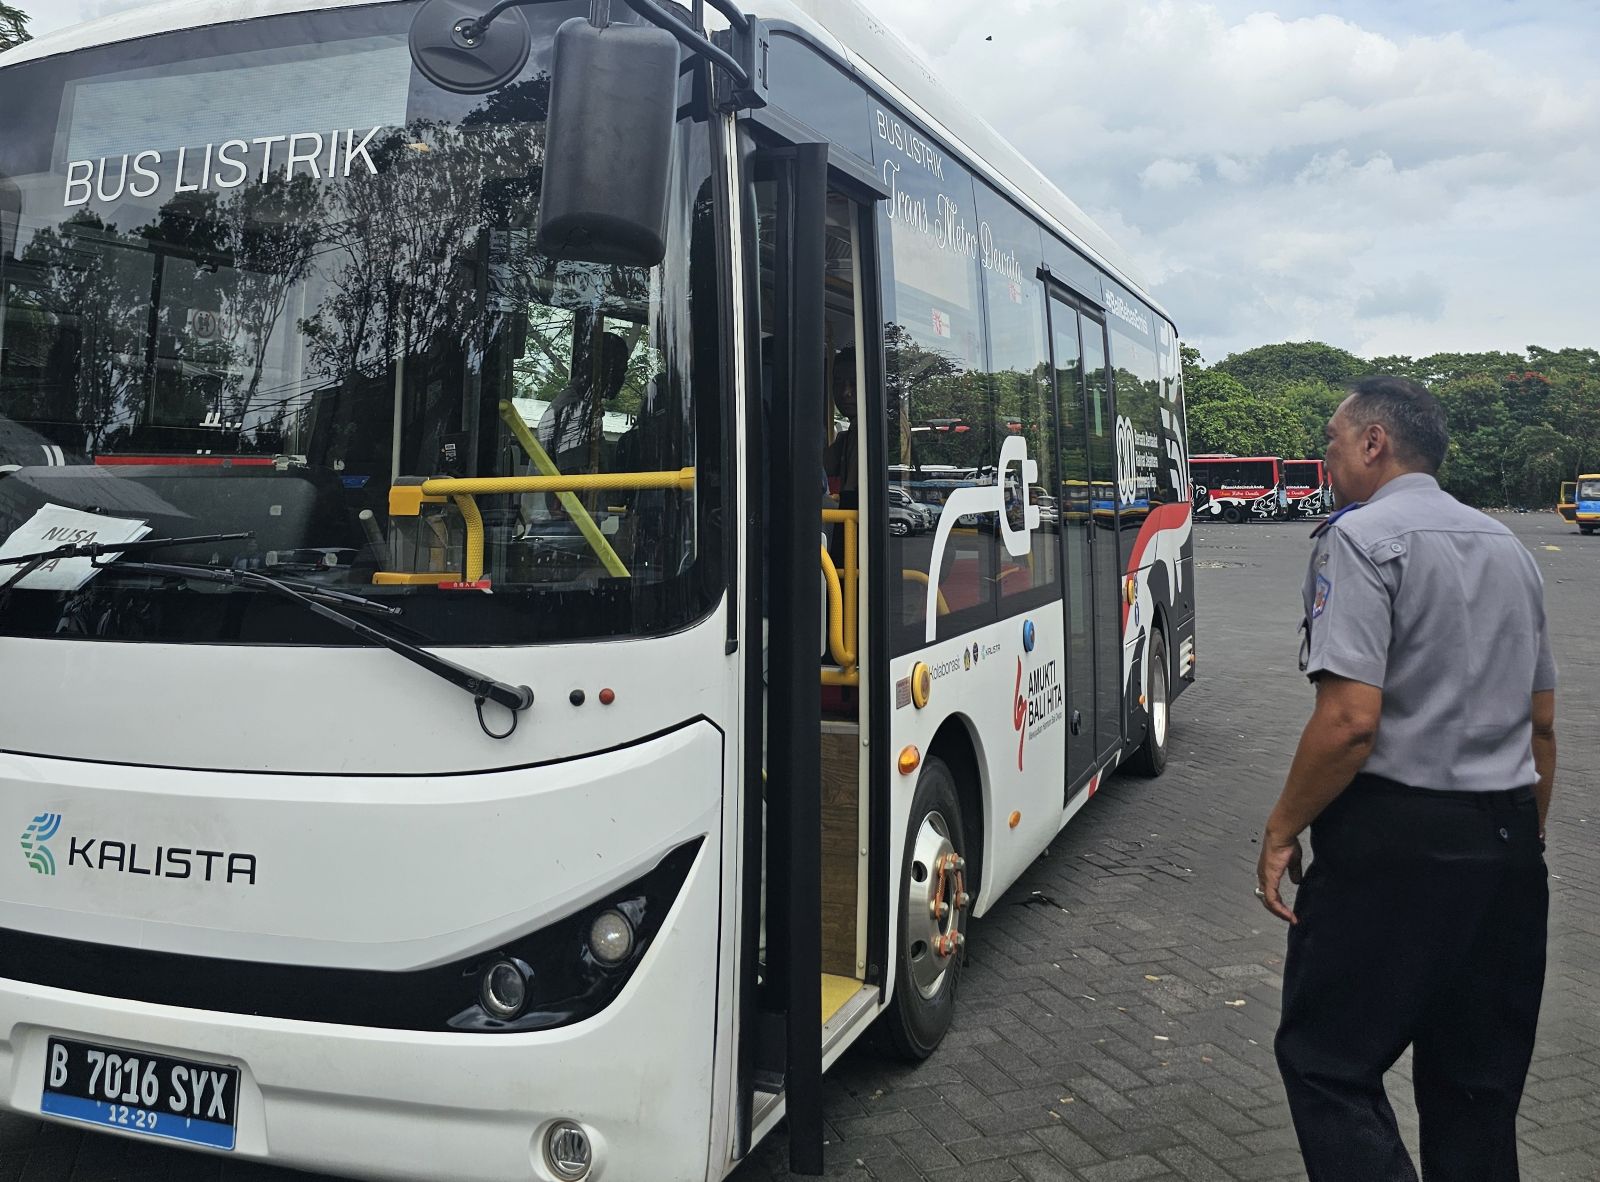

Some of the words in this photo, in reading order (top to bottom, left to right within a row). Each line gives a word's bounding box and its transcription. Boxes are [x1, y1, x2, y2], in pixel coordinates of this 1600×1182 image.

[63, 149, 162, 207] BUS
[174, 125, 382, 193] LISTRIK
[876, 109, 903, 151] BUS
[904, 130, 945, 181] LISTRIK
[883, 159, 928, 234] Trans
[934, 193, 977, 260] Metro
[981, 221, 1023, 285] Dewata
[1116, 414, 1135, 505] 80
[41, 526, 98, 545] NUSA
[1027, 659, 1056, 699] AMUKTI
[1028, 691, 1046, 727] BALI
[1047, 683, 1063, 715] HITA
[68, 836, 258, 885] KALISTA
[49, 1043, 70, 1088] B
[87, 1050, 160, 1106] 7016
[168, 1065, 229, 1120] SYX
